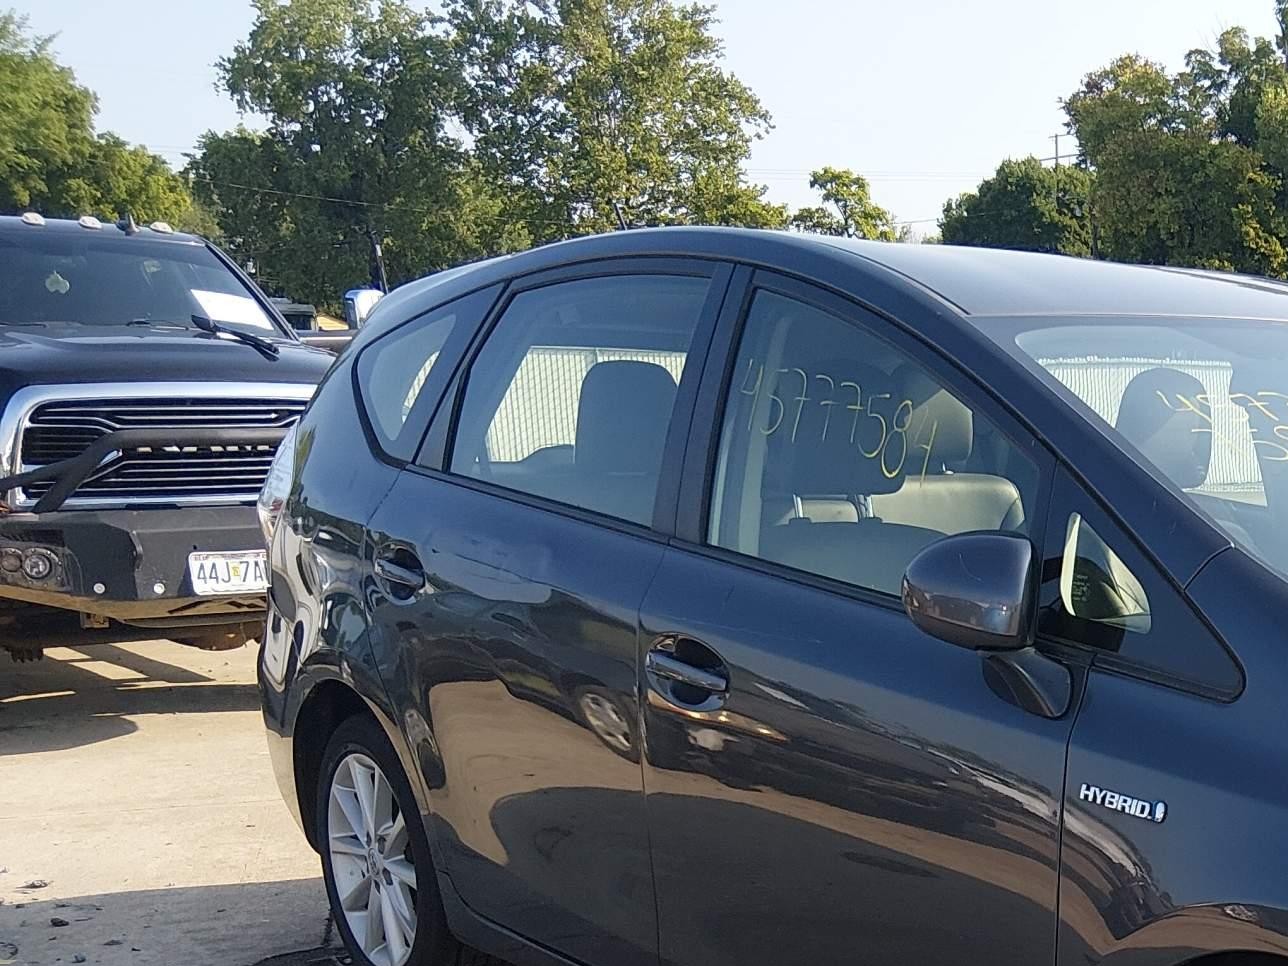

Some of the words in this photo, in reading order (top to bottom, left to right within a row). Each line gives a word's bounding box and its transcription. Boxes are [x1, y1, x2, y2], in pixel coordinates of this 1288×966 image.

[741, 358, 937, 488] 45777584
[197, 561, 231, 584] 44J
[240, 560, 267, 583] 7A
[1080, 783, 1152, 819] HYBRID
